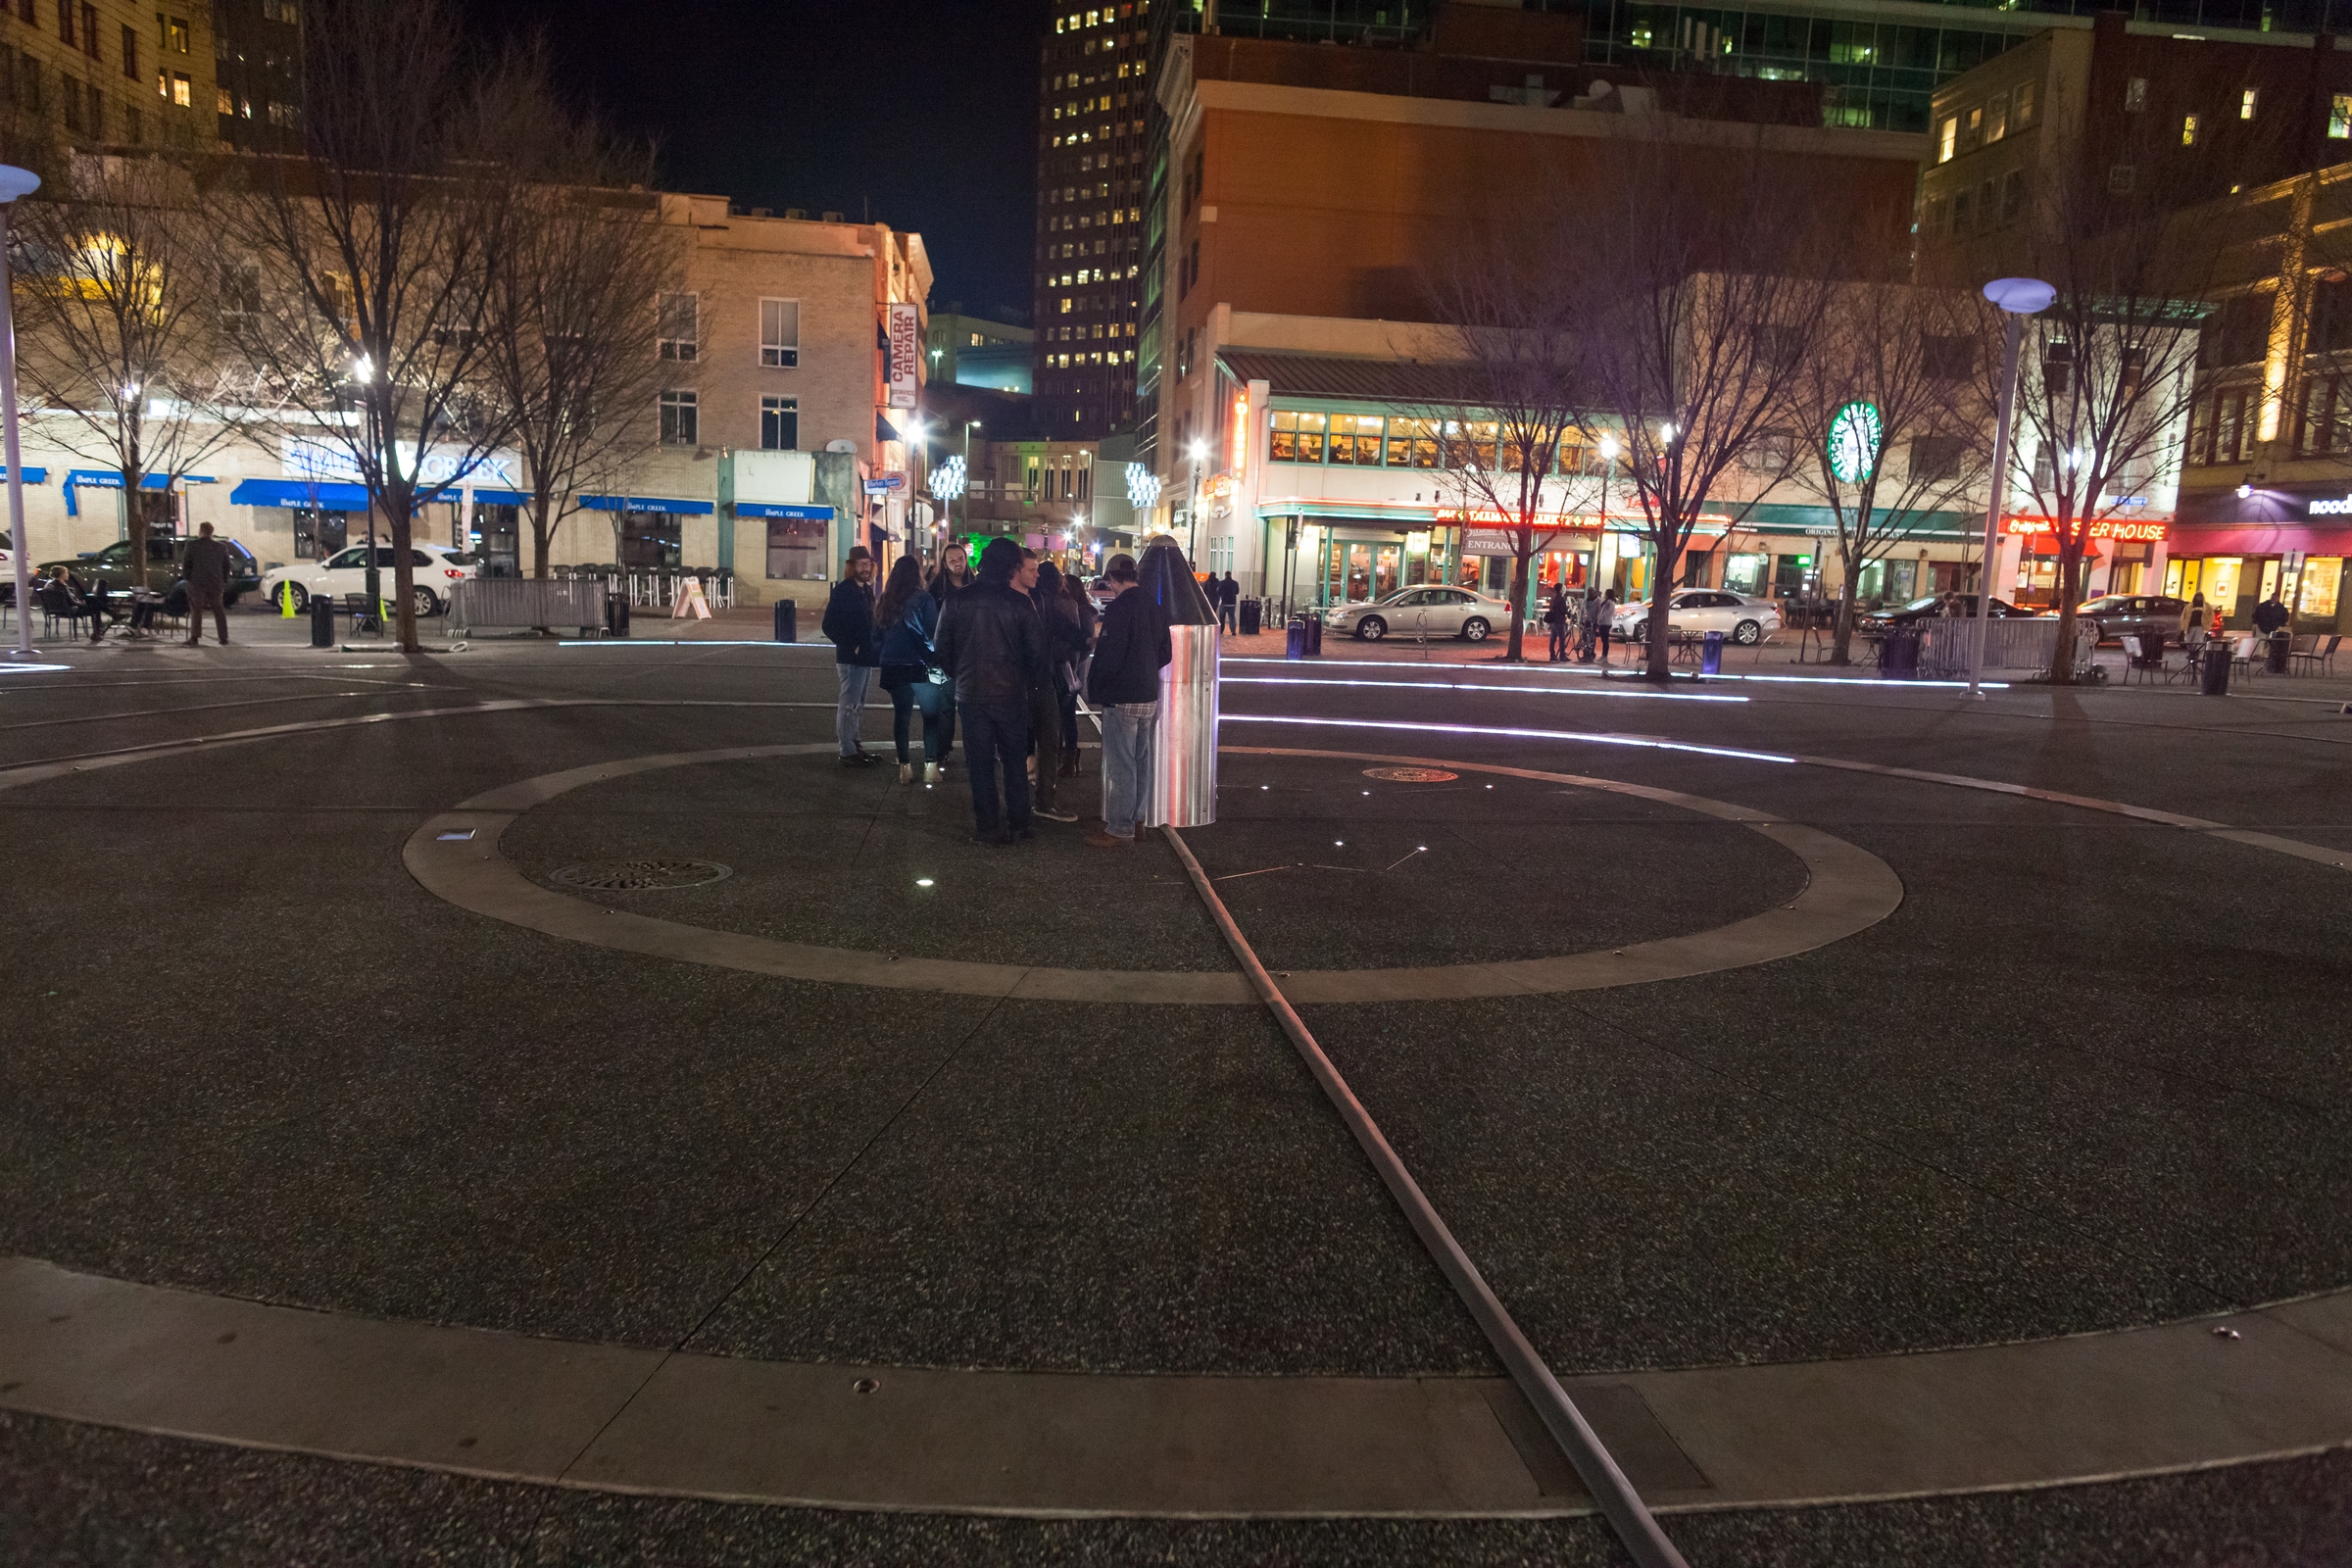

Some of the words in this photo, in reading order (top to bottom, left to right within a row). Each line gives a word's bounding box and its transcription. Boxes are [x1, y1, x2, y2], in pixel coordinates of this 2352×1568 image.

[892, 311, 904, 382] CAMERA
[904, 316, 914, 375] REPAIR
[288, 448, 377, 474] SIMPL
[423, 456, 512, 483] GREEK
[75, 475, 97, 484] SIMPLE
[1436, 509, 1456, 519] BAR
[2112, 523, 2166, 540] HOUSE
